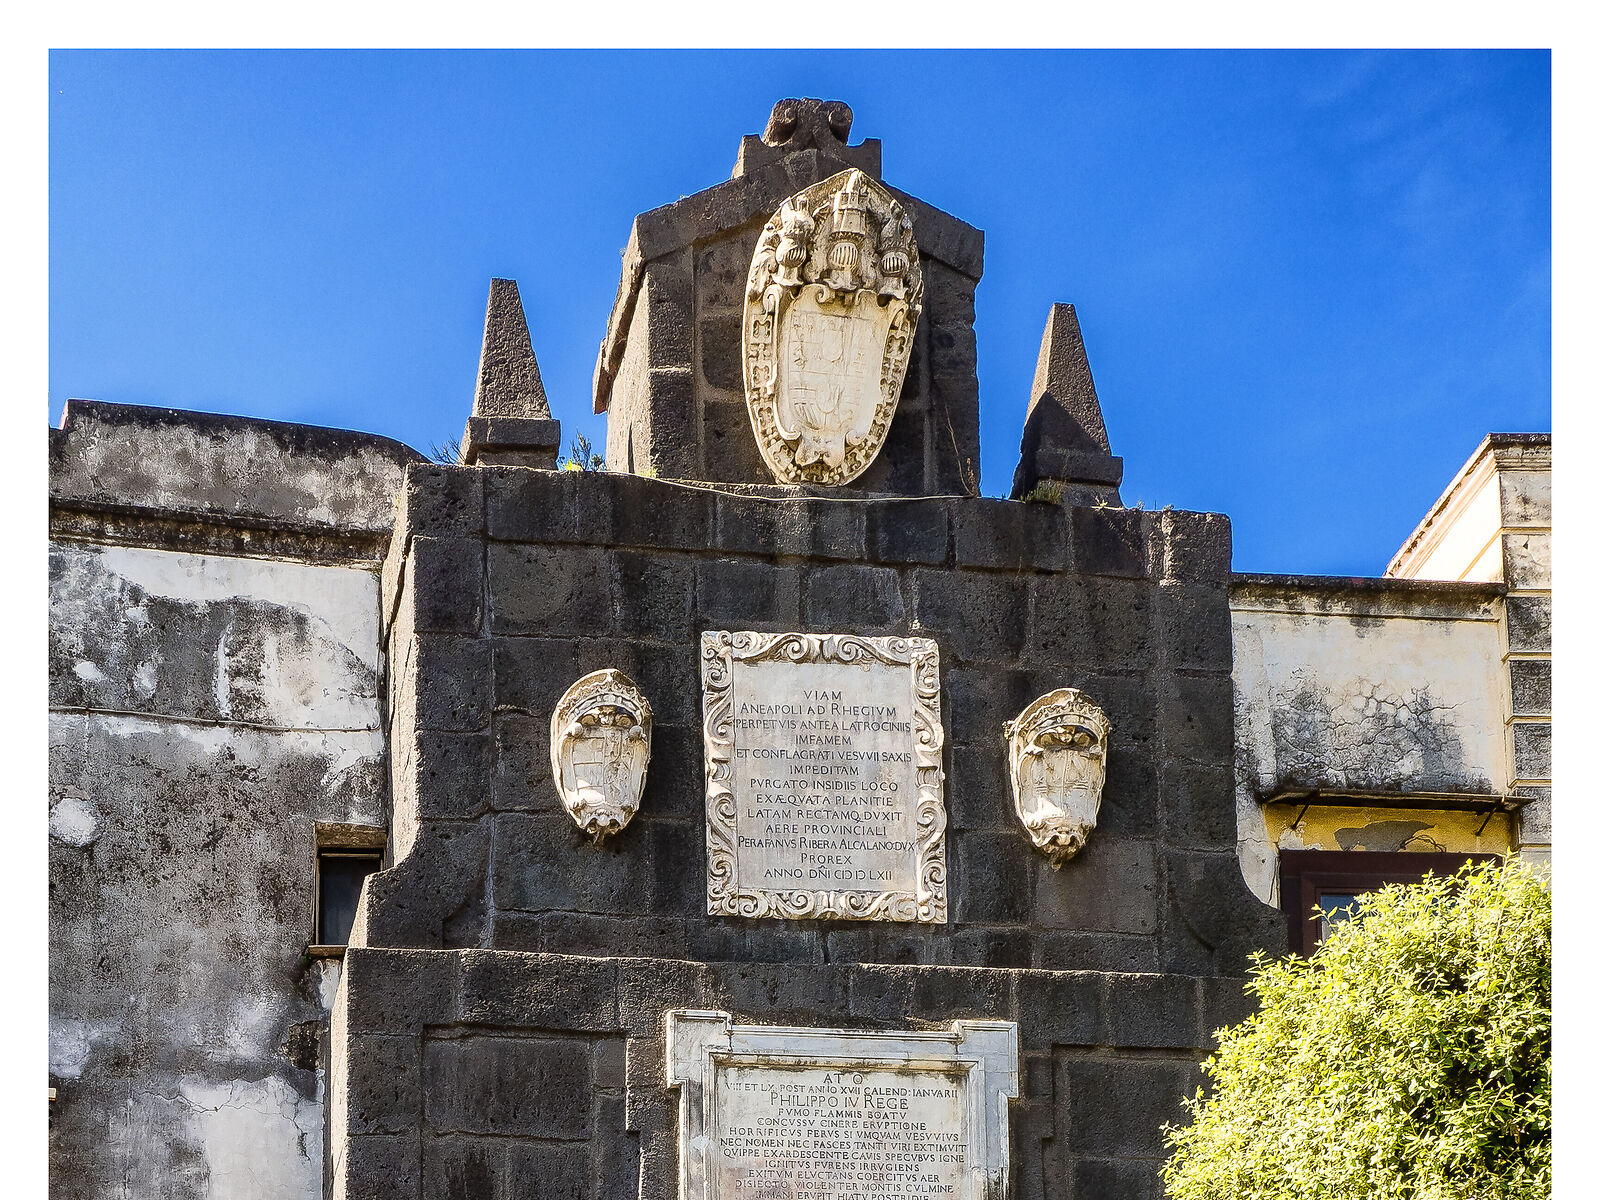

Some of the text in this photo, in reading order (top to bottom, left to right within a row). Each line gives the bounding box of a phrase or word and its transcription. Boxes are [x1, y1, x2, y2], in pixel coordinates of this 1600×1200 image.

[804, 690, 842, 700] VIAM
[740, 702, 896, 716] ANEAPOLI AD RHEGIVM
[736, 718, 911, 733] PERPETVIS ANTEA LATROCINIIS
[736, 748, 750, 758] ET
[752, 749, 834, 761] CONFLAGRATI
[882, 752, 912, 763] SAXIS
[790, 764, 860, 776] IMPEDITAM
[750, 778, 898, 792] PVRGATO INSIDIIS LOCO
[835, 796, 893, 806] PLANITIE
[747, 808, 902, 821] LATAM DVXIT
[765, 824, 886, 836] AERE PROVINCIALI
[738, 836, 796, 849] PERAFANVS
[799, 836, 838, 850] RIBERA
[800, 852, 852, 865] PROREX
[764, 868, 892, 880] ANNO LXII
[770, 1092, 909, 1110] PHILIPPO IV REGE
[778, 1108, 907, 1120] FVMO FLAMMIS BOATV
[756, 1118, 927, 1131] CONCVSSV CINERE ERVPTIONE
[844, 1130, 853, 1139] SI
[720, 1138, 851, 1150] NEC NOMEN NEC FASCES
[724, 1148, 965, 1163] QVIPPE EXARDESCENTE SPECVBVS IGNE
[765, 1160, 920, 1172] IGNITVS FVRENS IRRVGIENS
[748, 1170, 940, 1183] EXITVM ELVCTANS COERCITVS AER
[862, 1182, 901, 1192] MONTIS
